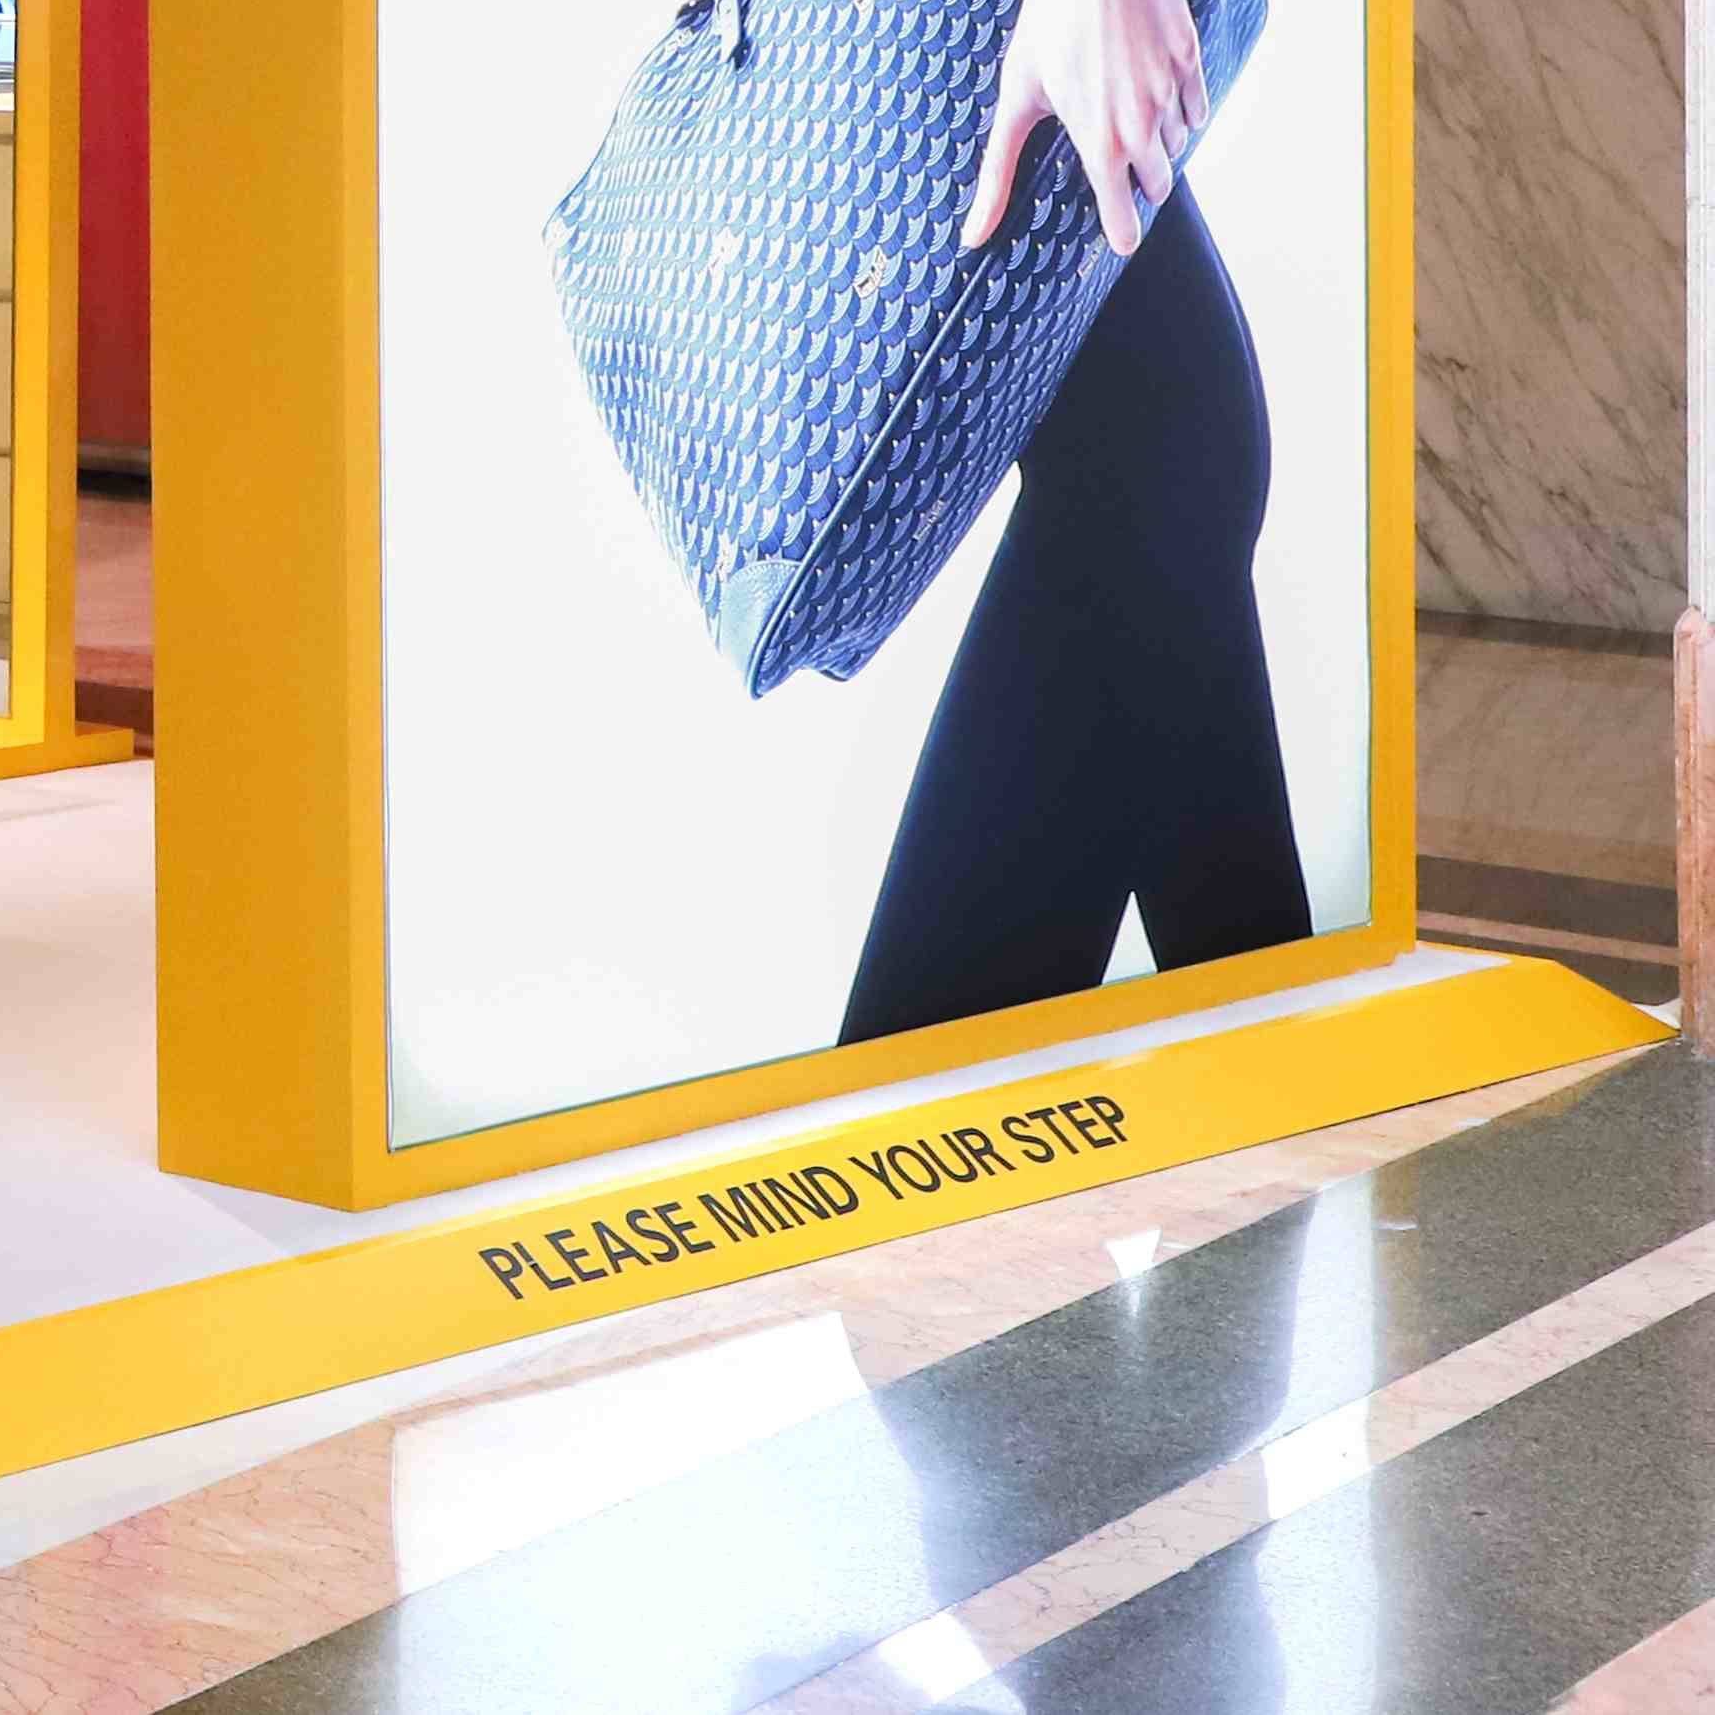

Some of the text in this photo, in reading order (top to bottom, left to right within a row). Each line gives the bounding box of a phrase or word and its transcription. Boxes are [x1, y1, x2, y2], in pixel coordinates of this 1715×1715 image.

[479, 1096, 1127, 1299] PLEASE MIND YOUR STEP
